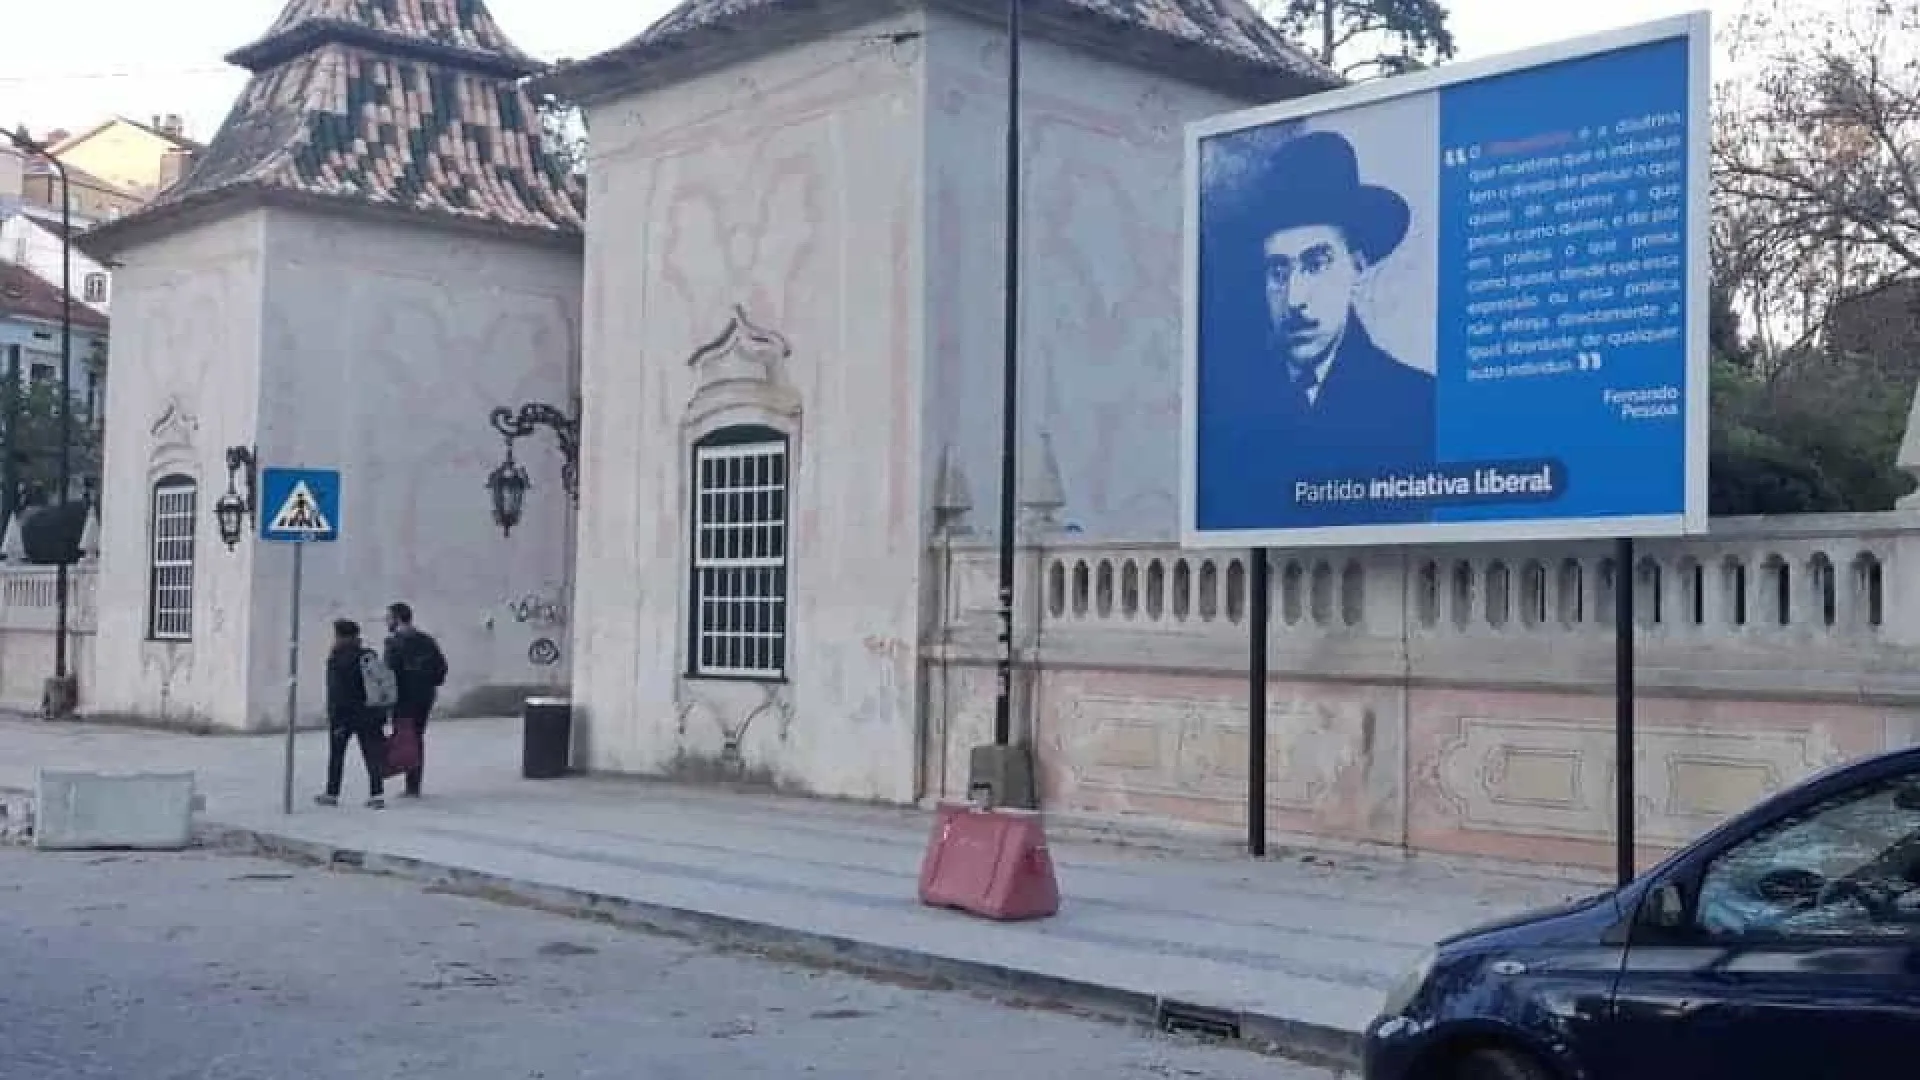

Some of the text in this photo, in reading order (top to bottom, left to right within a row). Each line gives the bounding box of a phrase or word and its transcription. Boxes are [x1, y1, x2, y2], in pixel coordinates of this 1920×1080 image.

[1562, 152, 1591, 165] que
[1604, 386, 1679, 404] Fernando
[1621, 403, 1678, 420] Pessoa
[1295, 479, 1365, 502] Partido
[1369, 472, 1469, 499] iniciativa
